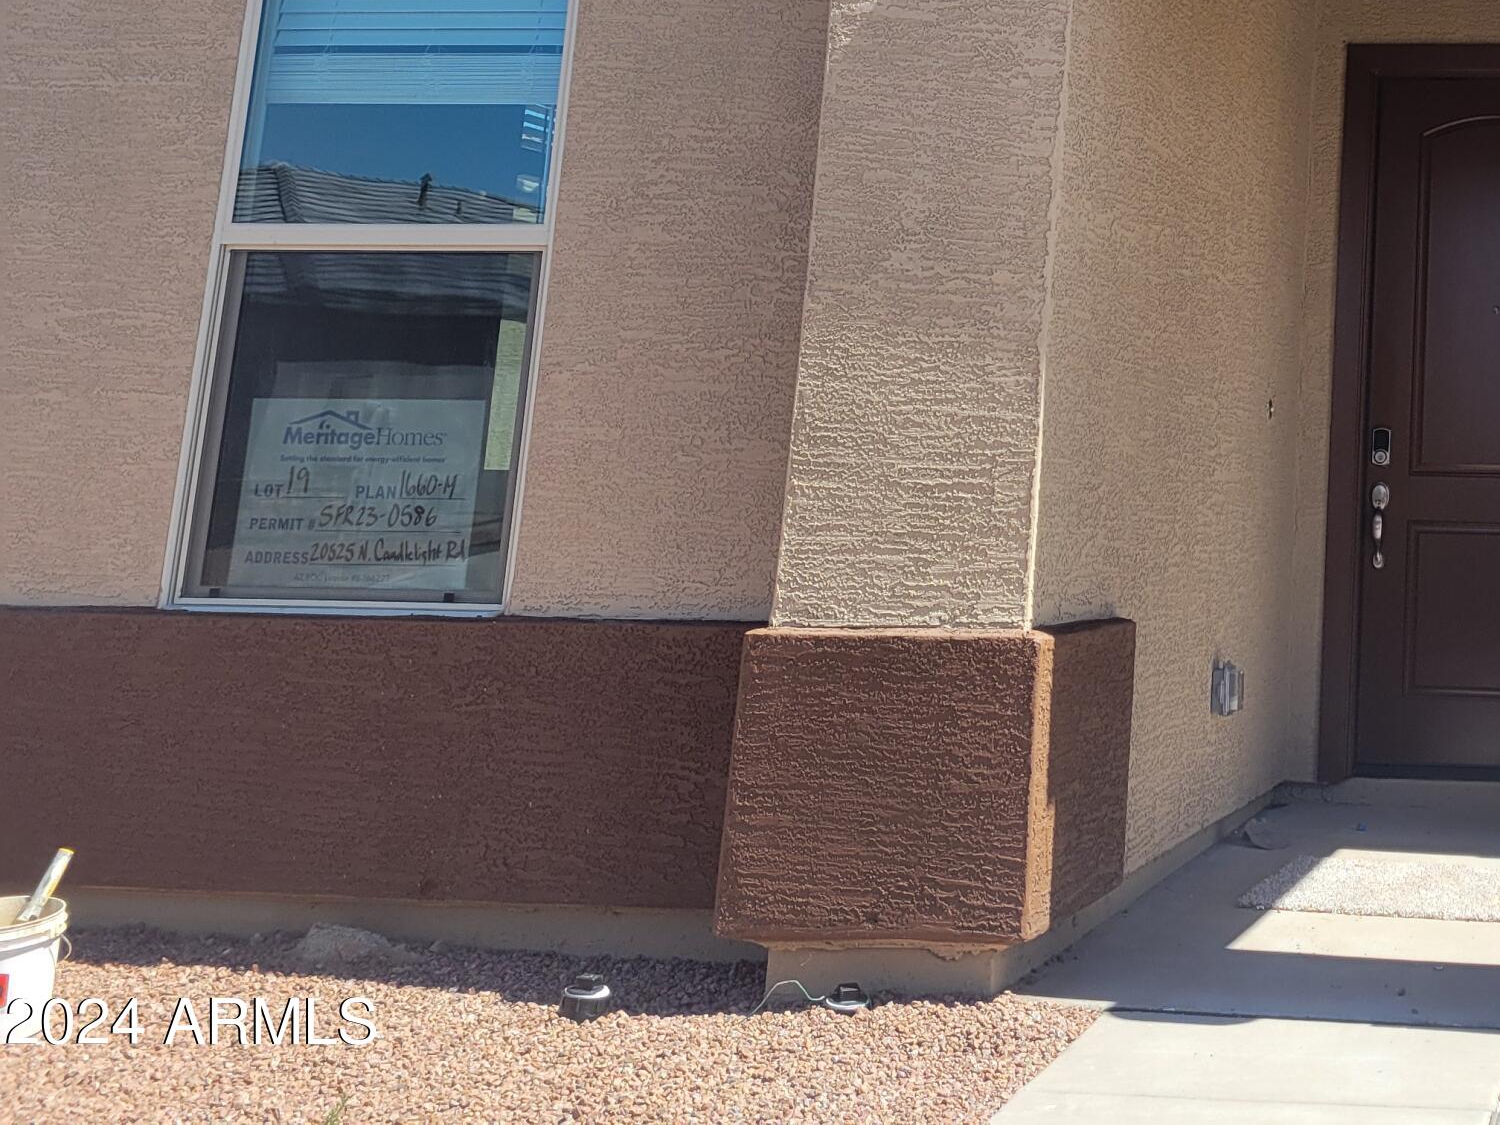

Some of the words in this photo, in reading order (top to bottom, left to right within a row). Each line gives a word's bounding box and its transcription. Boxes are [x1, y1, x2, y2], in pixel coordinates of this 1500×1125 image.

[306, 454, 318, 463] the
[320, 454, 352, 463] standard
[353, 454, 364, 463] for
[254, 484, 284, 498] LOT
[286, 465, 310, 494] 19
[355, 485, 397, 499] PLAN
[249, 517, 304, 530] PERMIT
[319, 503, 438, 527] SFR23-0586
[245, 550, 309, 564] ADDRESS
[309, 542, 355, 563] 20525
[445, 538, 466, 563] Rd
